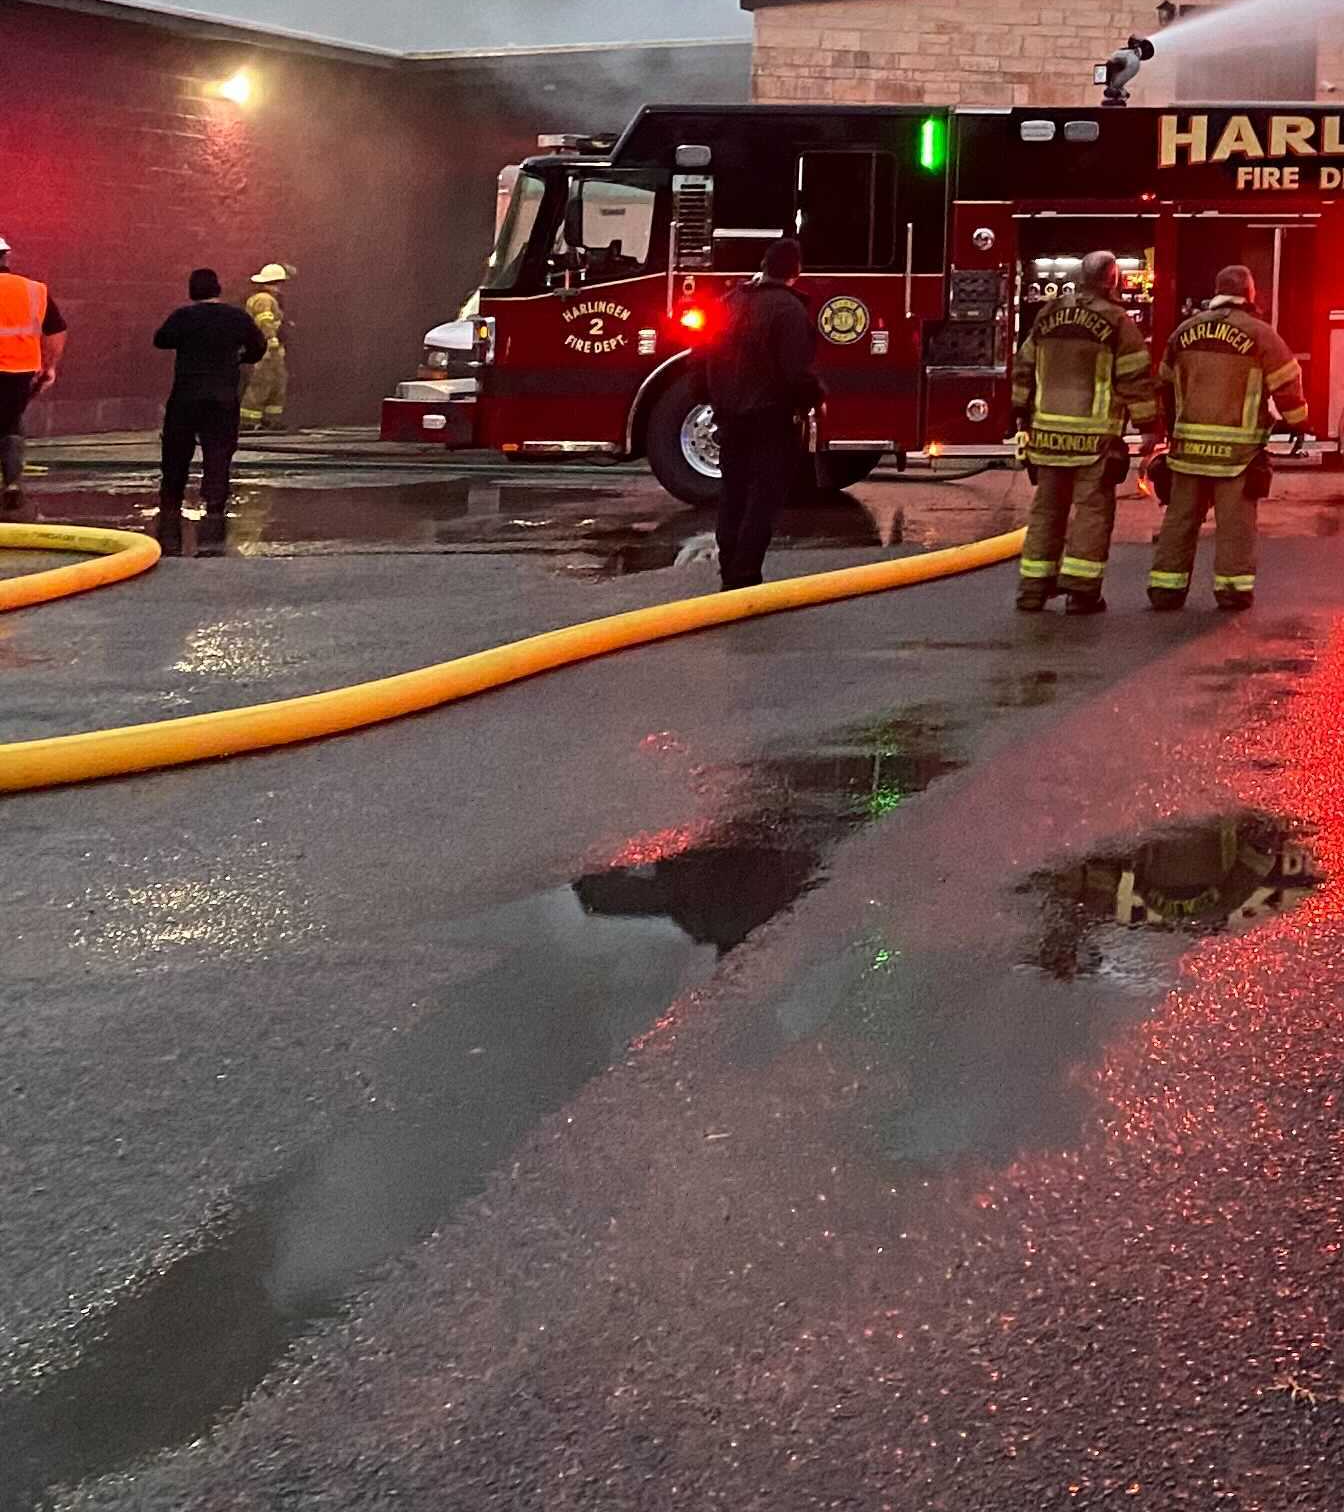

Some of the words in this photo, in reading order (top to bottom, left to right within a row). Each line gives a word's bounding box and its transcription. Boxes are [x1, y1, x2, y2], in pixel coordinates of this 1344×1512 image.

[1236, 167, 1300, 190] FIRE
[562, 301, 631, 322] HARLINGEN
[589, 318, 604, 335] 2
[1039, 307, 1113, 342] HARLINGEN
[564, 334, 592, 353] FIRE
[1180, 322, 1254, 354] HARLINGEN
